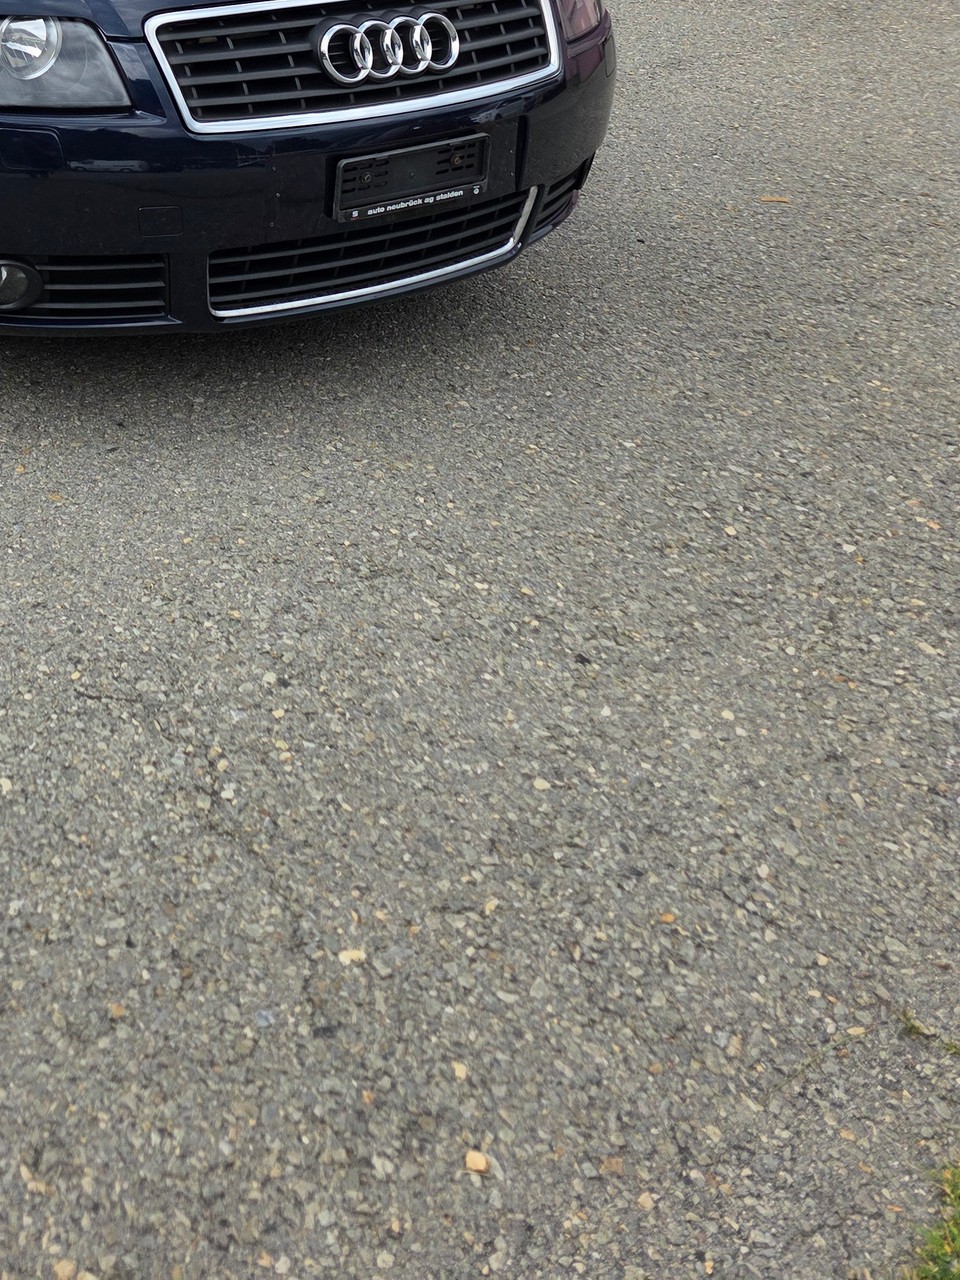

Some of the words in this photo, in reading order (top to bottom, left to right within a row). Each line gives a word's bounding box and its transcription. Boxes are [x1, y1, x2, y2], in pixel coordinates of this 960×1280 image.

[367, 207, 385, 215] auto
[424, 196, 434, 204] ag
[435, 190, 464, 201] stalden
